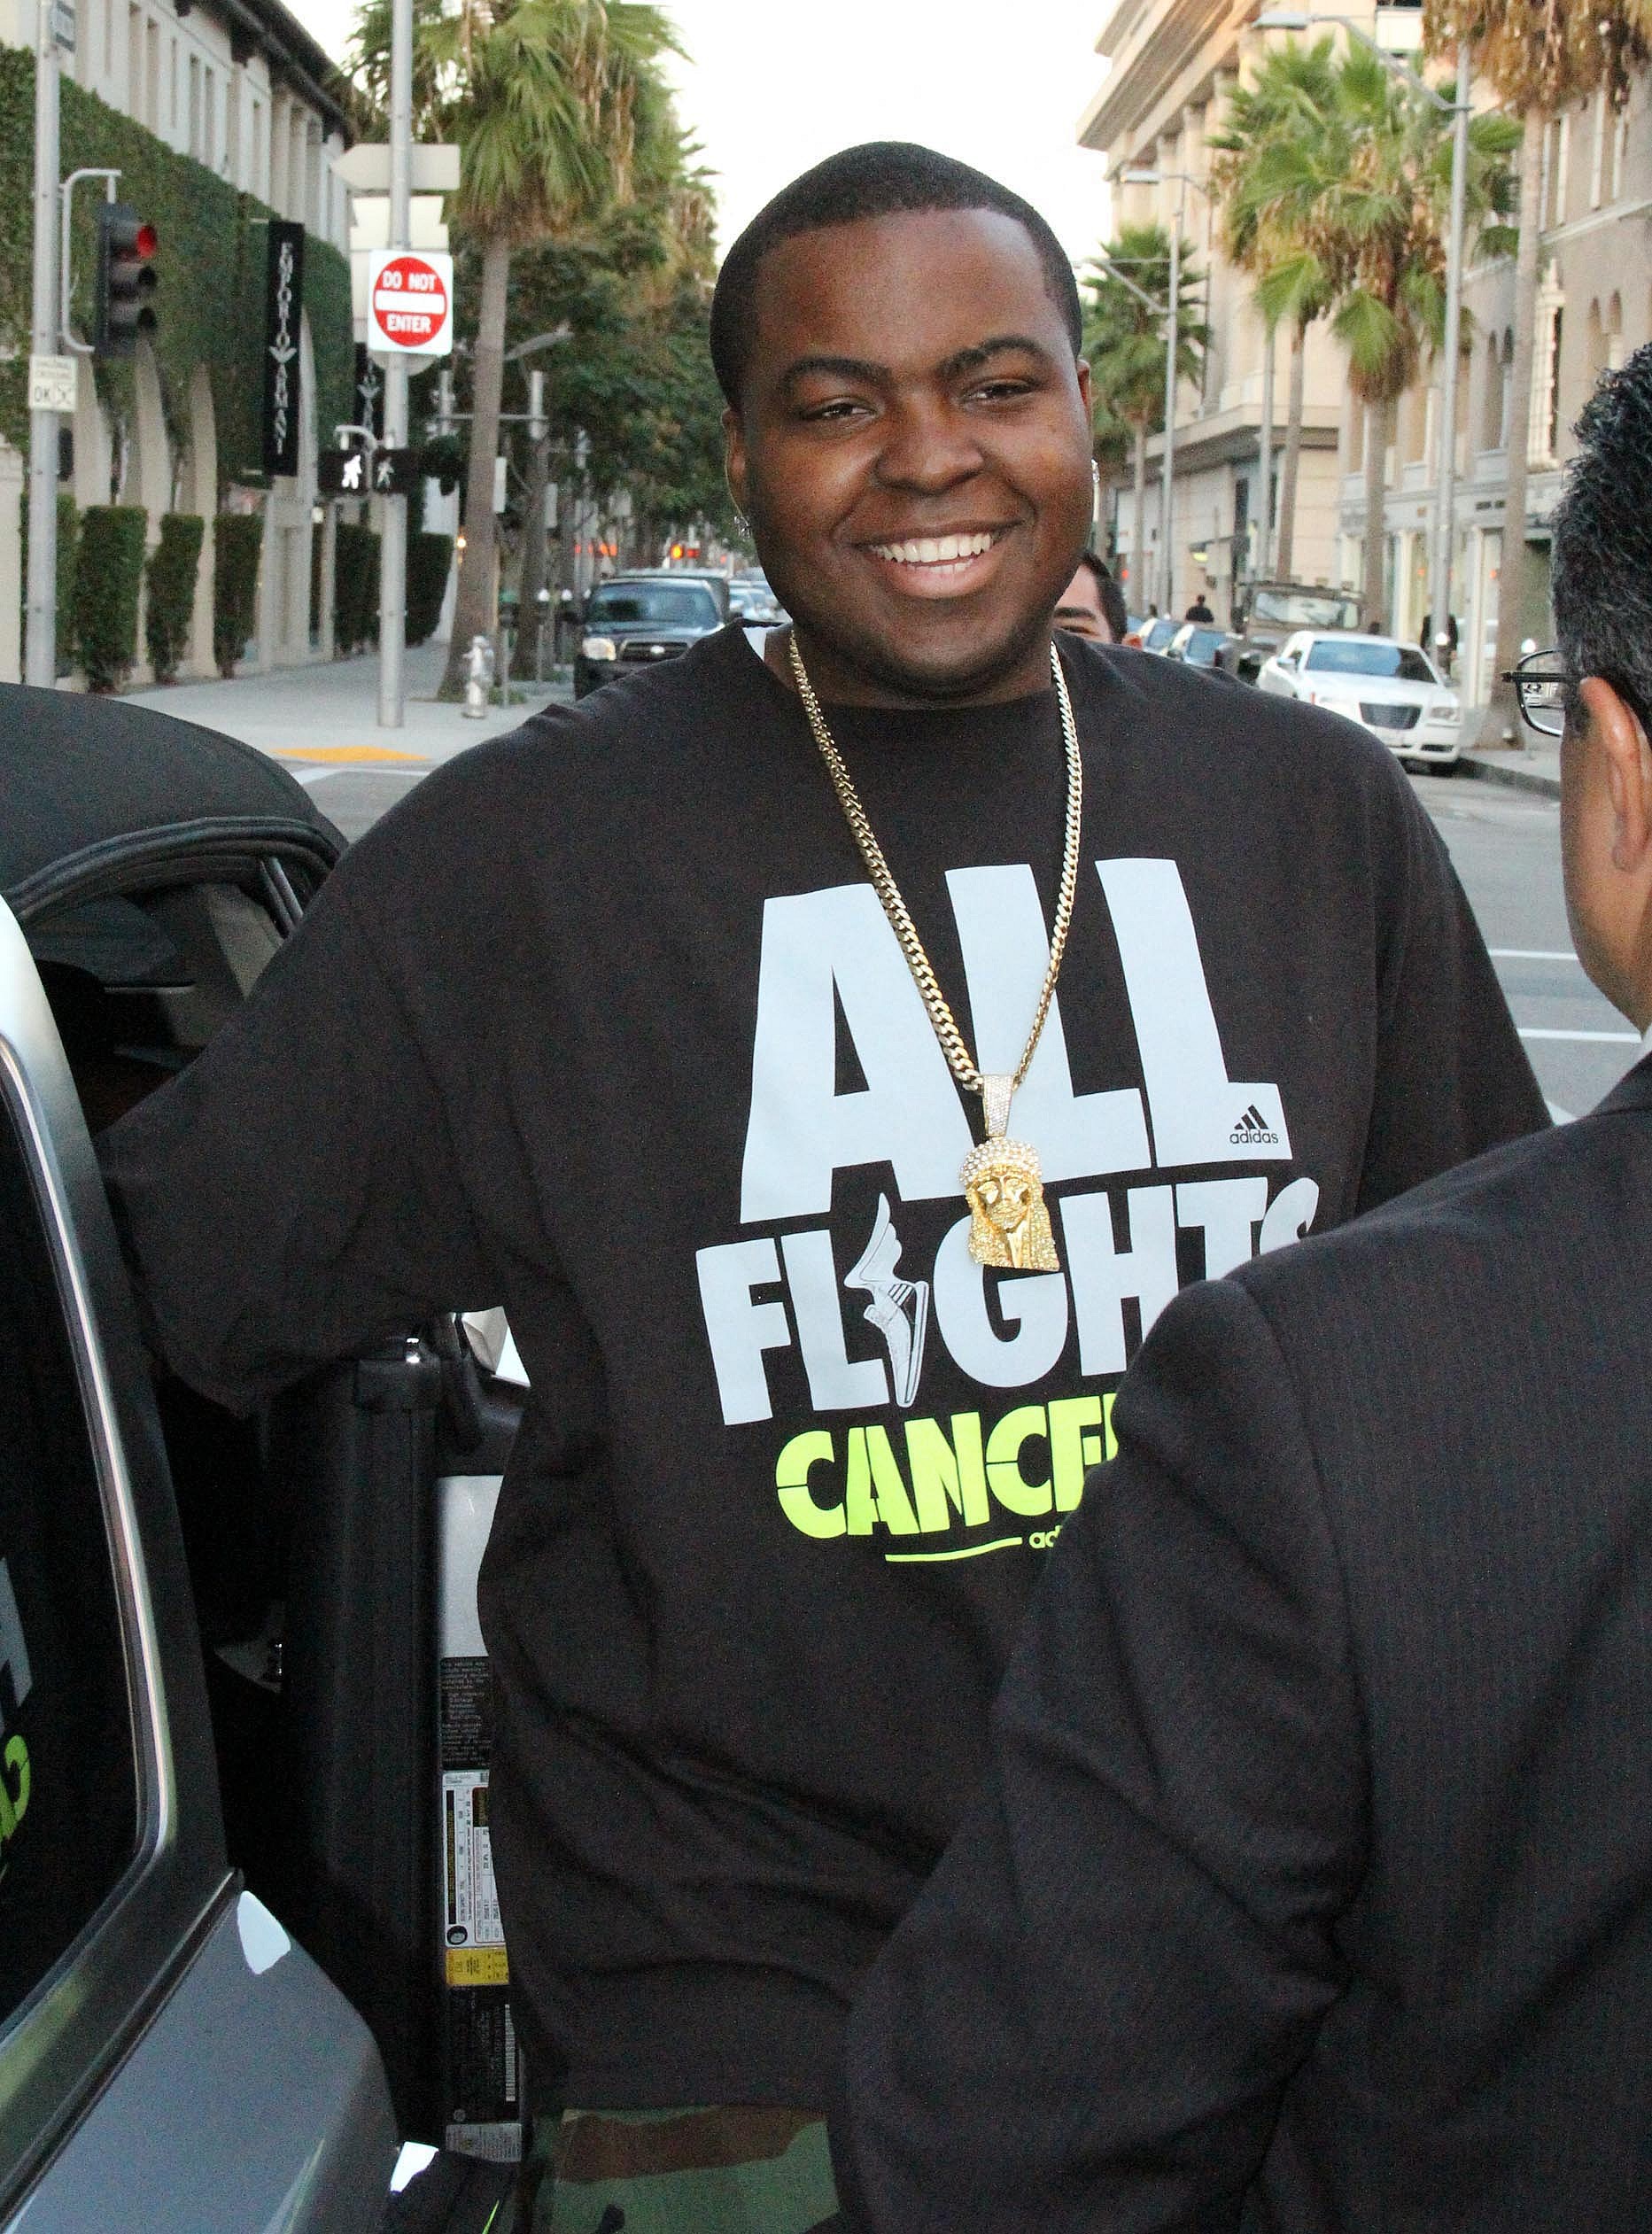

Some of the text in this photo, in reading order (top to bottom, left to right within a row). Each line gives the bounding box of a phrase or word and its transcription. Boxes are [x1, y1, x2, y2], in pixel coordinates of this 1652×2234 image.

[383, 270, 438, 291] DO NOT
[386, 314, 432, 334] ENTER
[740, 857, 1293, 1222] ALL
[1229, 1129, 1280, 1144] adidas
[775, 1392, 1119, 1539] CANCE
